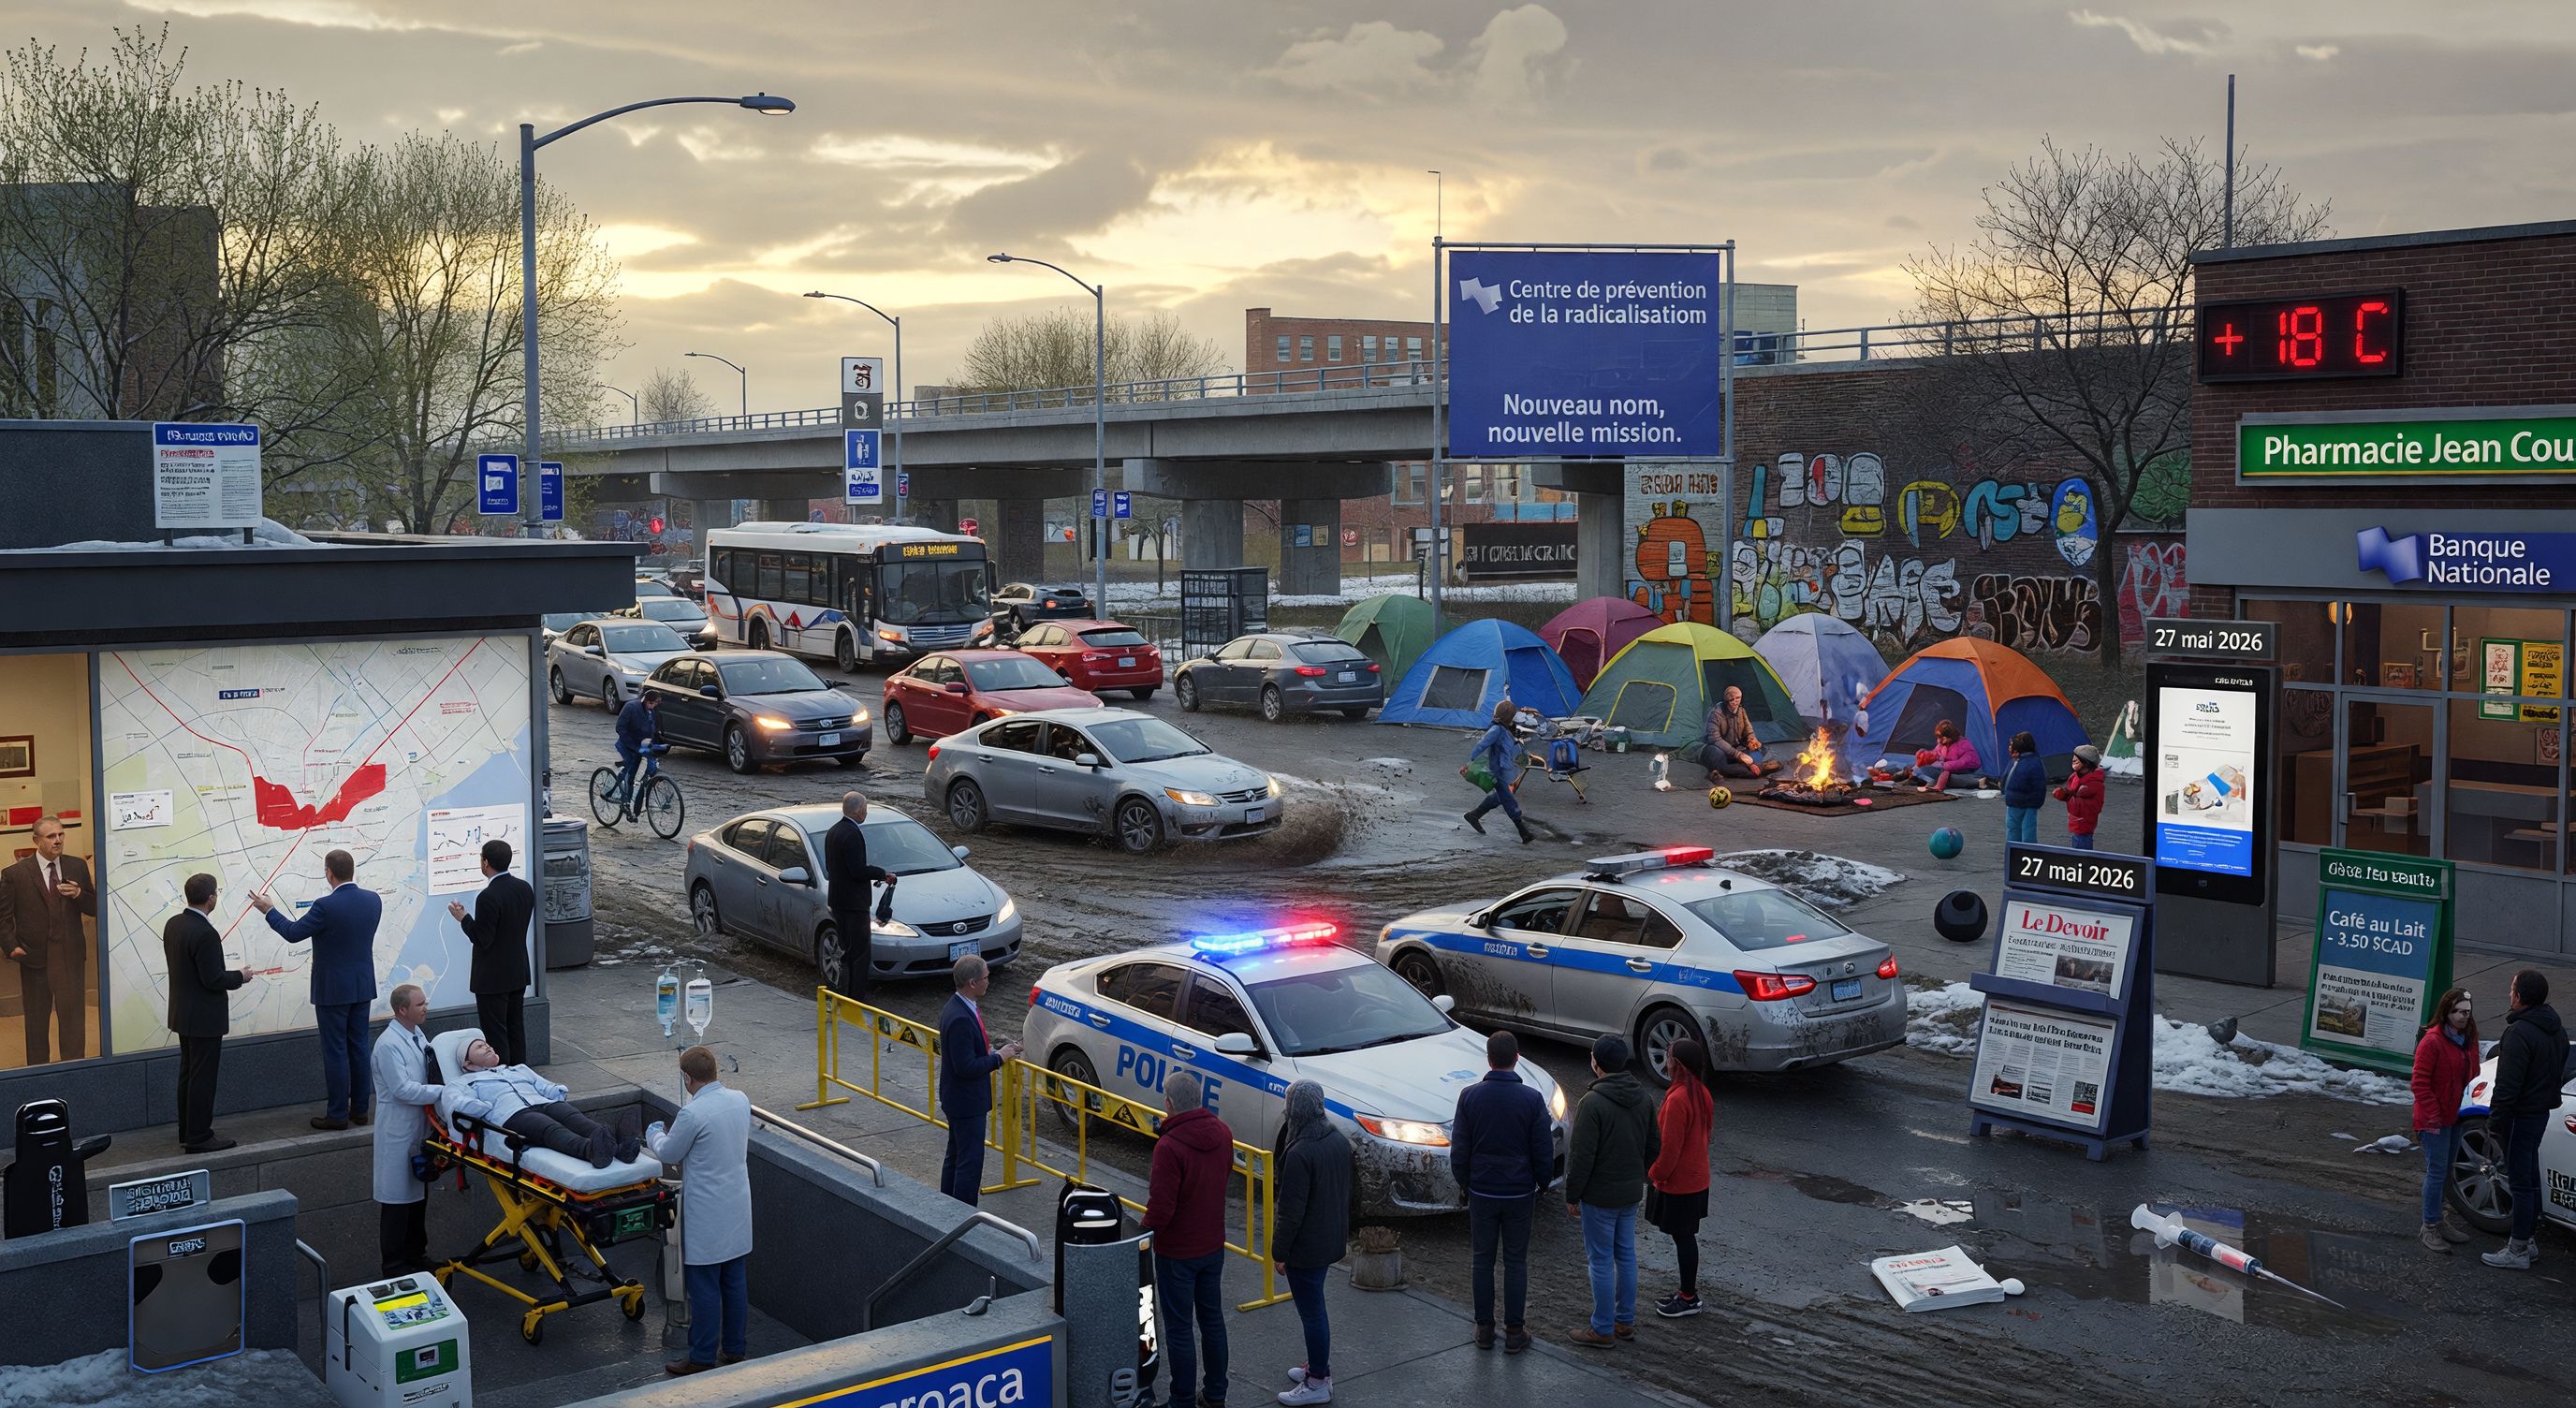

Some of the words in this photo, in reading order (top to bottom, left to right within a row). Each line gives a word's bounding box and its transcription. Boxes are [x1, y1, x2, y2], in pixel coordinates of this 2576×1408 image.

[1509, 280, 1572, 299] Centre
[1576, 280, 1601, 299] de
[1605, 280, 1706, 303] prévention
[1509, 304, 1534, 324] de
[1541, 303, 1559, 324] la
[2279, 306, 2323, 367] 18
[2355, 301, 2388, 363] C
[1503, 394, 1603, 416] Nouveau
[1609, 398, 1665, 419] nom,
[1488, 421, 1585, 443] nouvelle
[1591, 422, 1682, 443] mission.
[2264, 433, 2423, 465] Pharmacie
[2428, 433, 2501, 463] Jean
[2510, 431, 2575, 462] Cou
[2429, 534, 2526, 564] Banque
[2428, 562, 2551, 587] Nationale
[2155, 629, 2176, 647] 27
[2181, 631, 2213, 649] mai
[2217, 632, 2263, 652] 2026
[2020, 857, 2043, 877] 27
[2049, 863, 2083, 883] mai
[2087, 866, 2134, 889] 2026
[2022, 910, 2043, 931] Le
[2045, 914, 2109, 941] Devoir
[2329, 910, 2365, 930] Café
[2369, 919, 2390, 933] au
[2394, 919, 2426, 938] Lait
[1117, 1045, 1222, 1117] POLE
